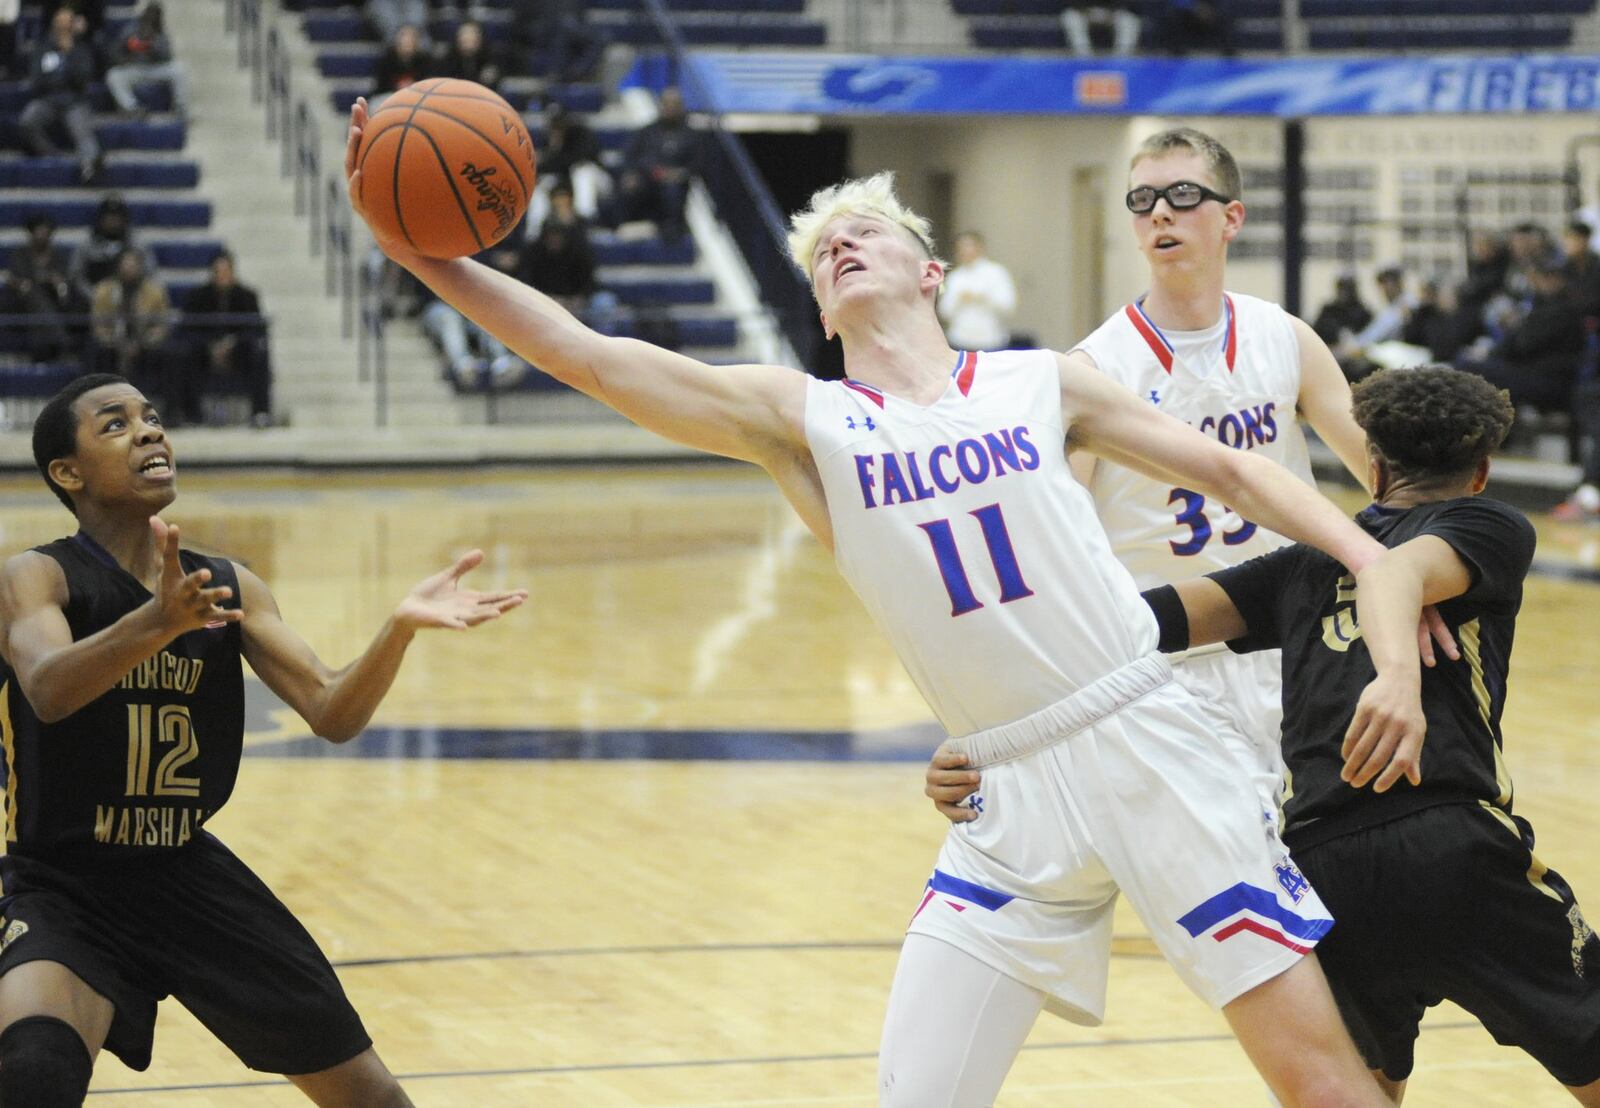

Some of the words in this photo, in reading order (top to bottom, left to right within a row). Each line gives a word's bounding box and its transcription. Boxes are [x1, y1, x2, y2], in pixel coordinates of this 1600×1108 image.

[854, 426, 1040, 510] FALCONS
[916, 503, 1034, 617] 11
[124, 703, 201, 797] 12
